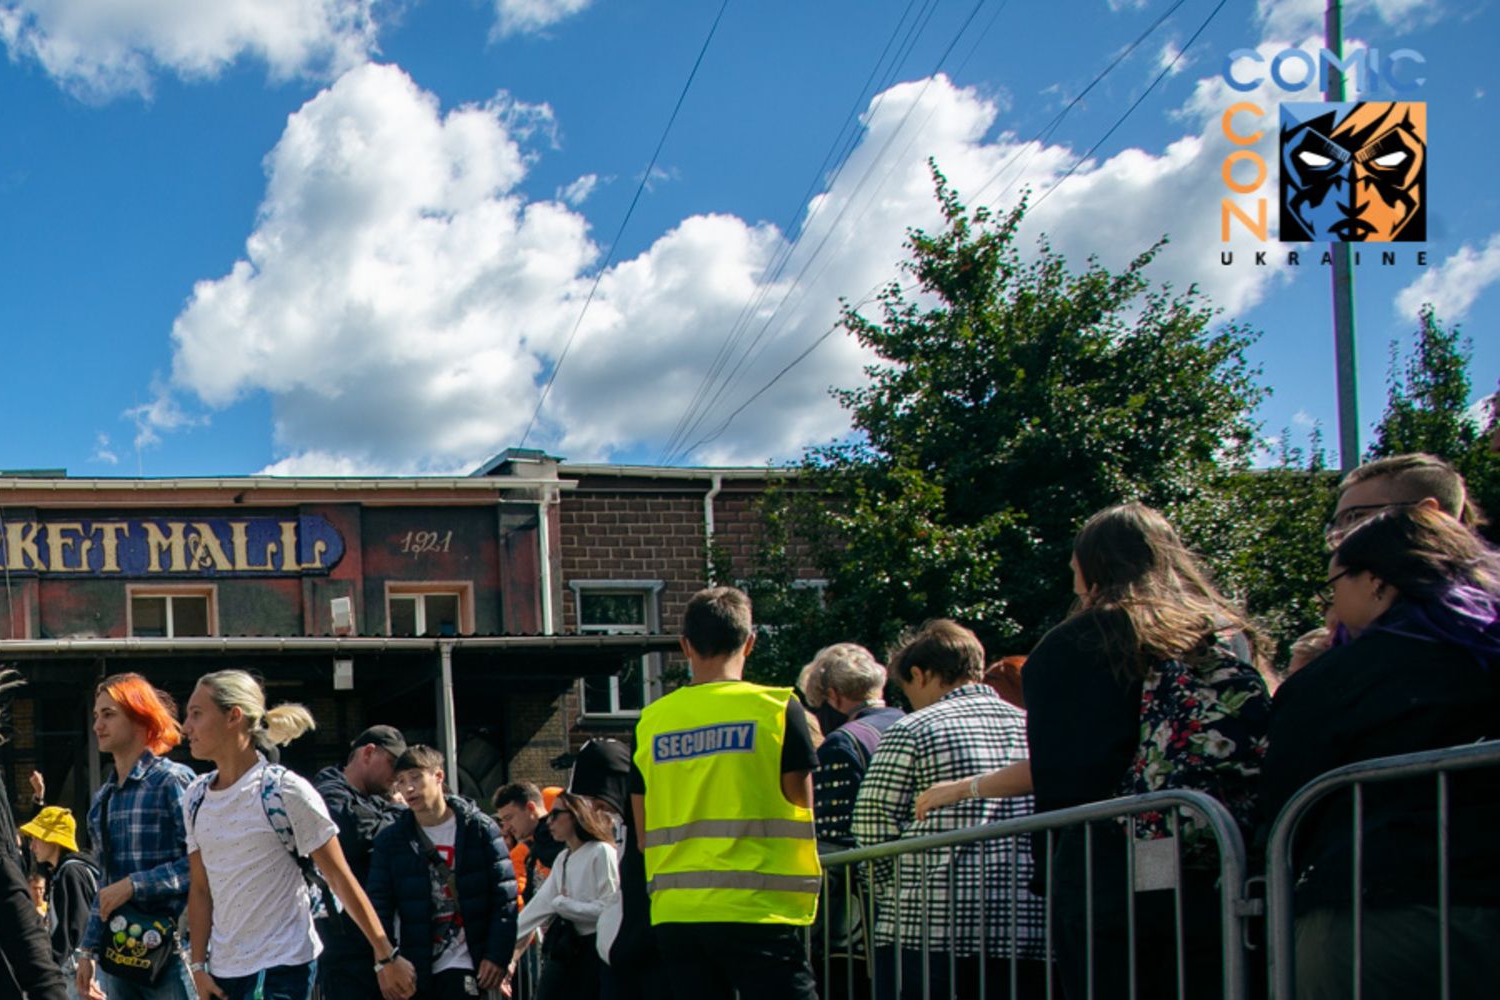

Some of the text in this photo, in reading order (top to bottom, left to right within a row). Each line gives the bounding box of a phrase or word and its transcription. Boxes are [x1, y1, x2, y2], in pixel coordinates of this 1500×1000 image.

[142, 519, 327, 575] MALL
[400, 530, 453, 560] 1921
[657, 726, 749, 758] SECURITY
